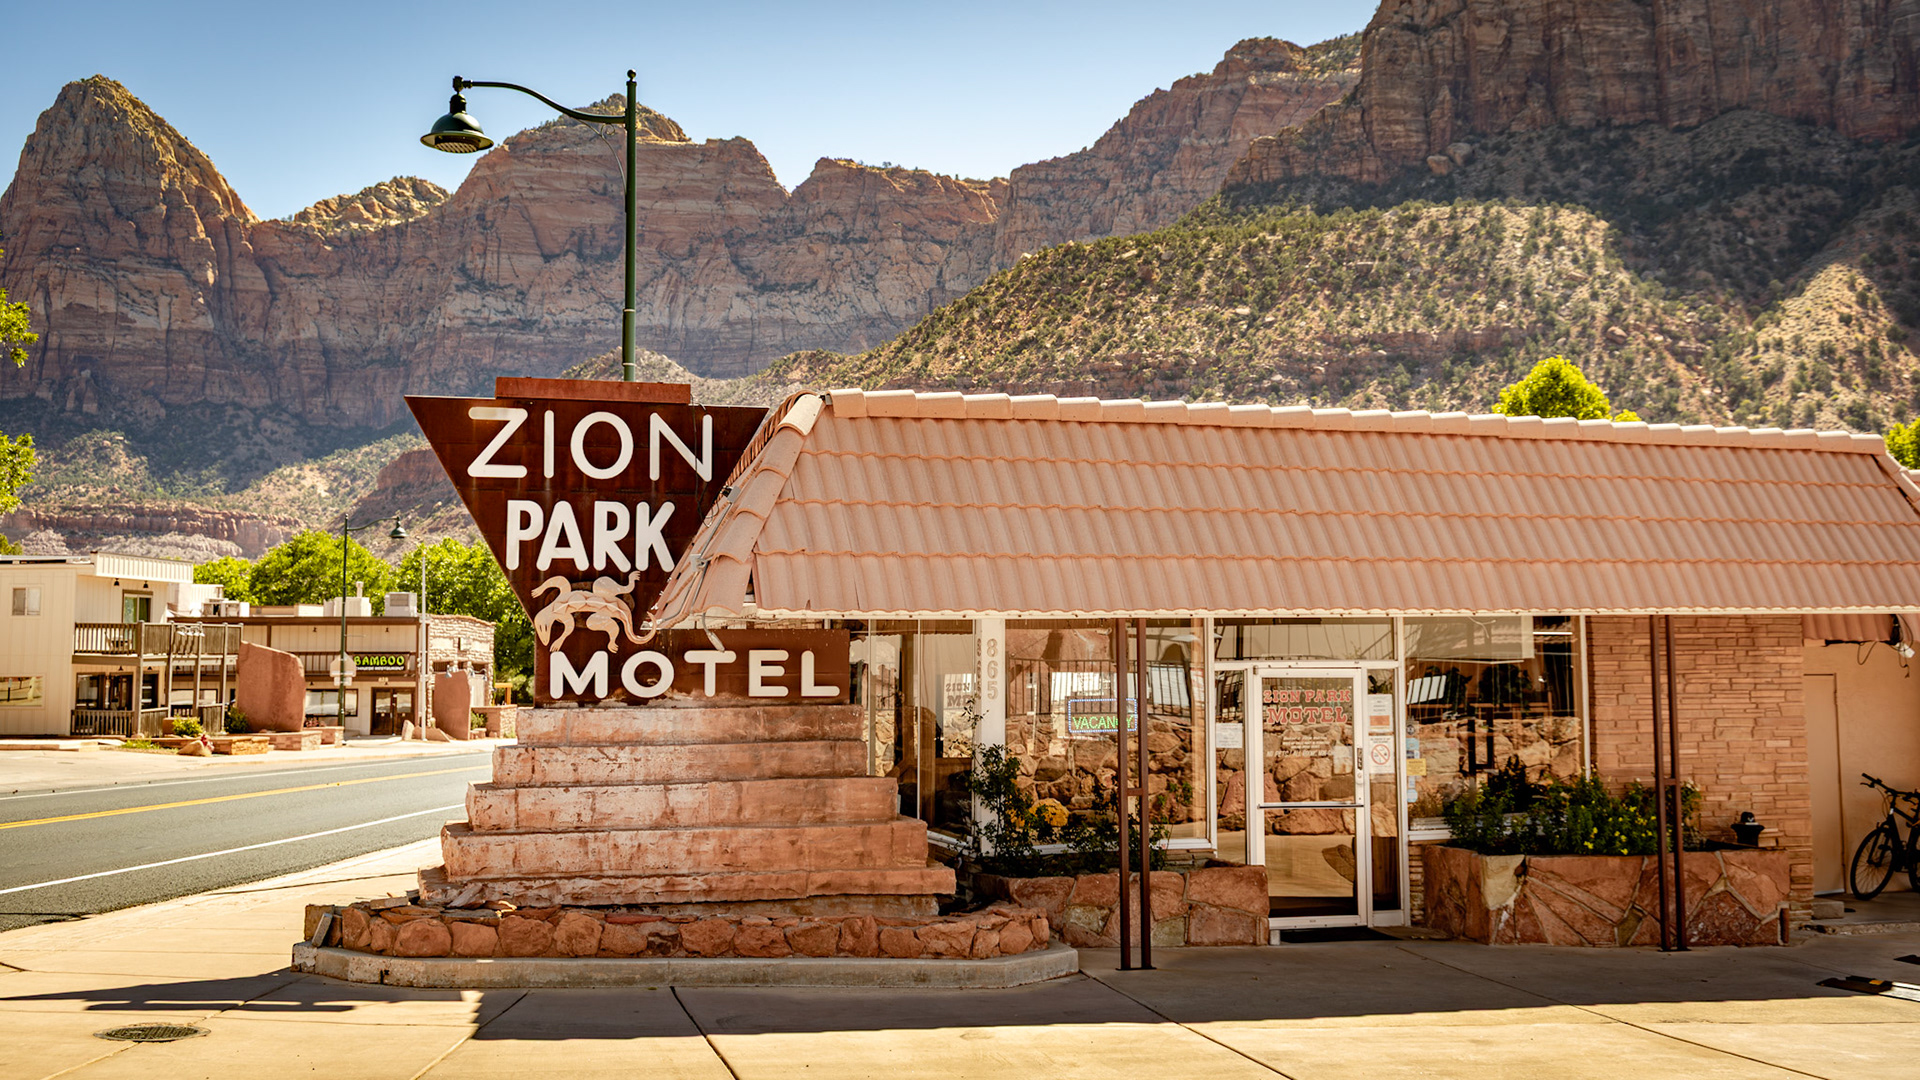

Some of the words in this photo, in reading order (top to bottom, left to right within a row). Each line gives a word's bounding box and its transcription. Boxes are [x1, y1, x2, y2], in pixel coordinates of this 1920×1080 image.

[467, 407, 713, 482] ZION
[505, 499, 675, 573] PARK
[354, 655, 405, 665] BAMBOO
[549, 650, 840, 700] MOTEL
[986, 638, 999, 700] 865
[1263, 689, 1301, 703] ZION
[1304, 689, 1351, 703] PARK
[1072, 715, 1134, 729] VACANY
[1267, 706, 1347, 724] MOTEL
